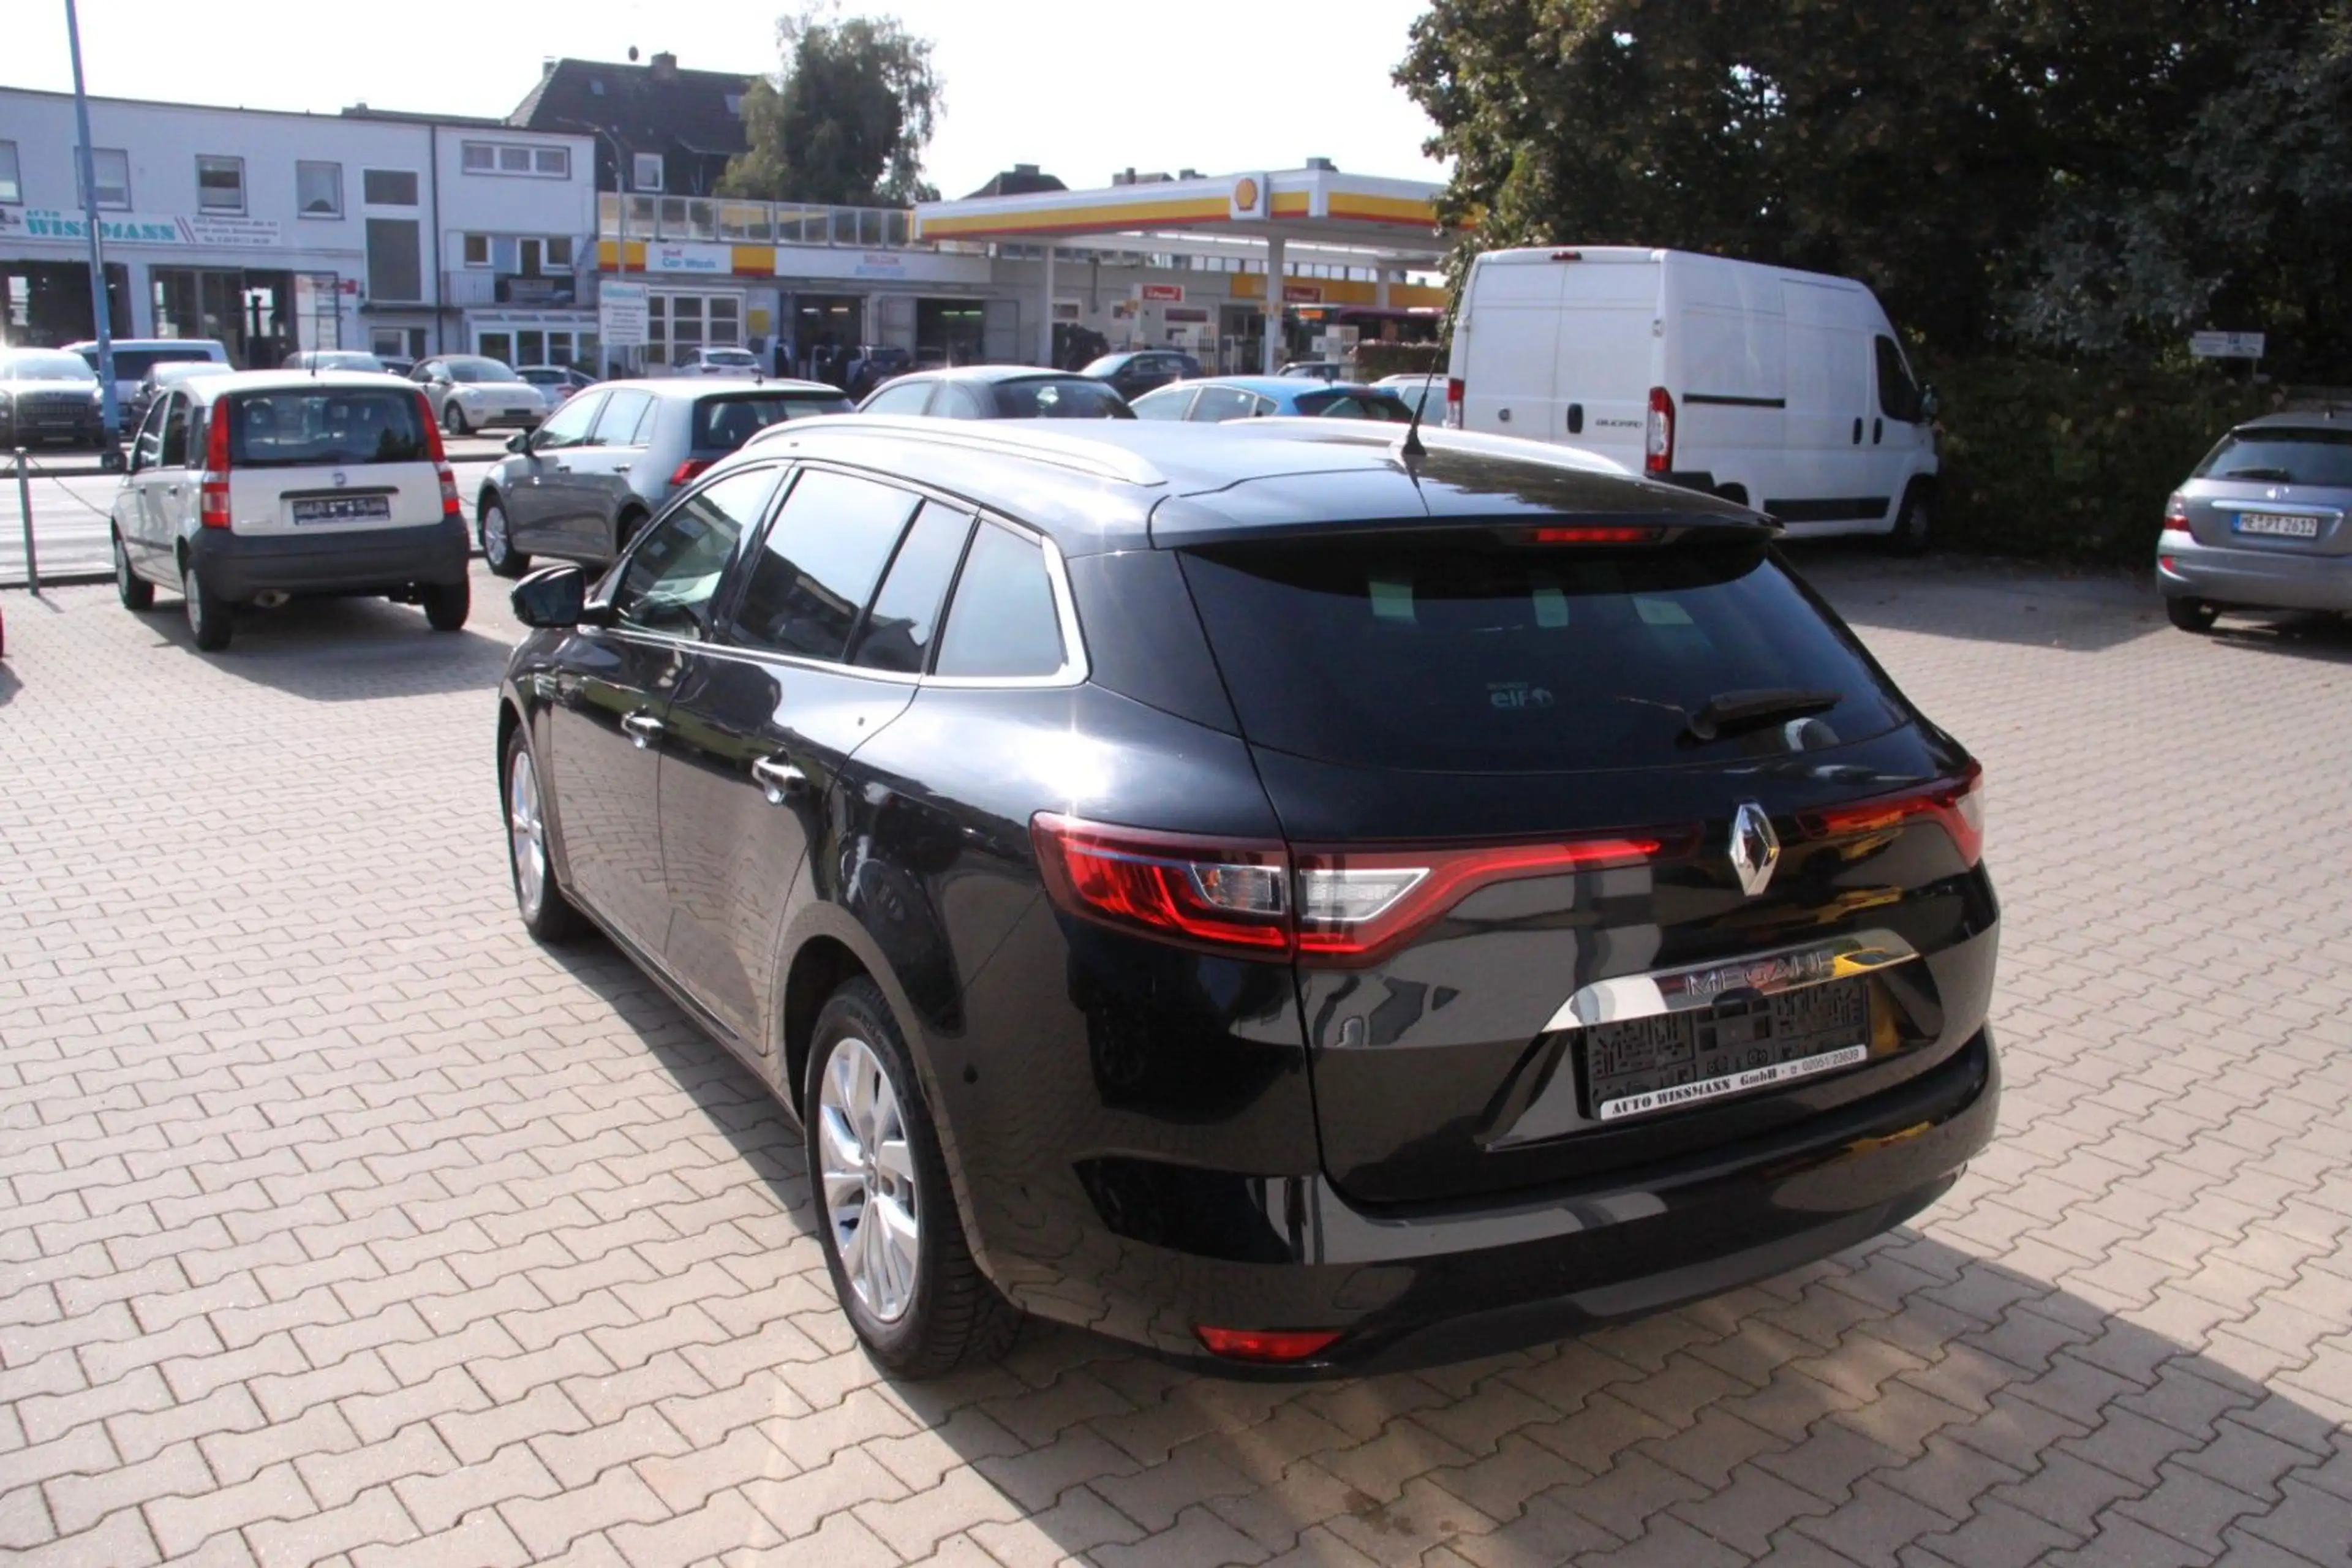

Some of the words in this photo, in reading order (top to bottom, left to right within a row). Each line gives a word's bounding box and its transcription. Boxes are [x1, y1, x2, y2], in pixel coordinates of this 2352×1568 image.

[662, 257, 682, 268] Car
[1612, 1095, 1652, 1115] AUTO
[1656, 1077, 1731, 1104] WISSMANN
[1740, 1068, 1776, 1086] GmbH
